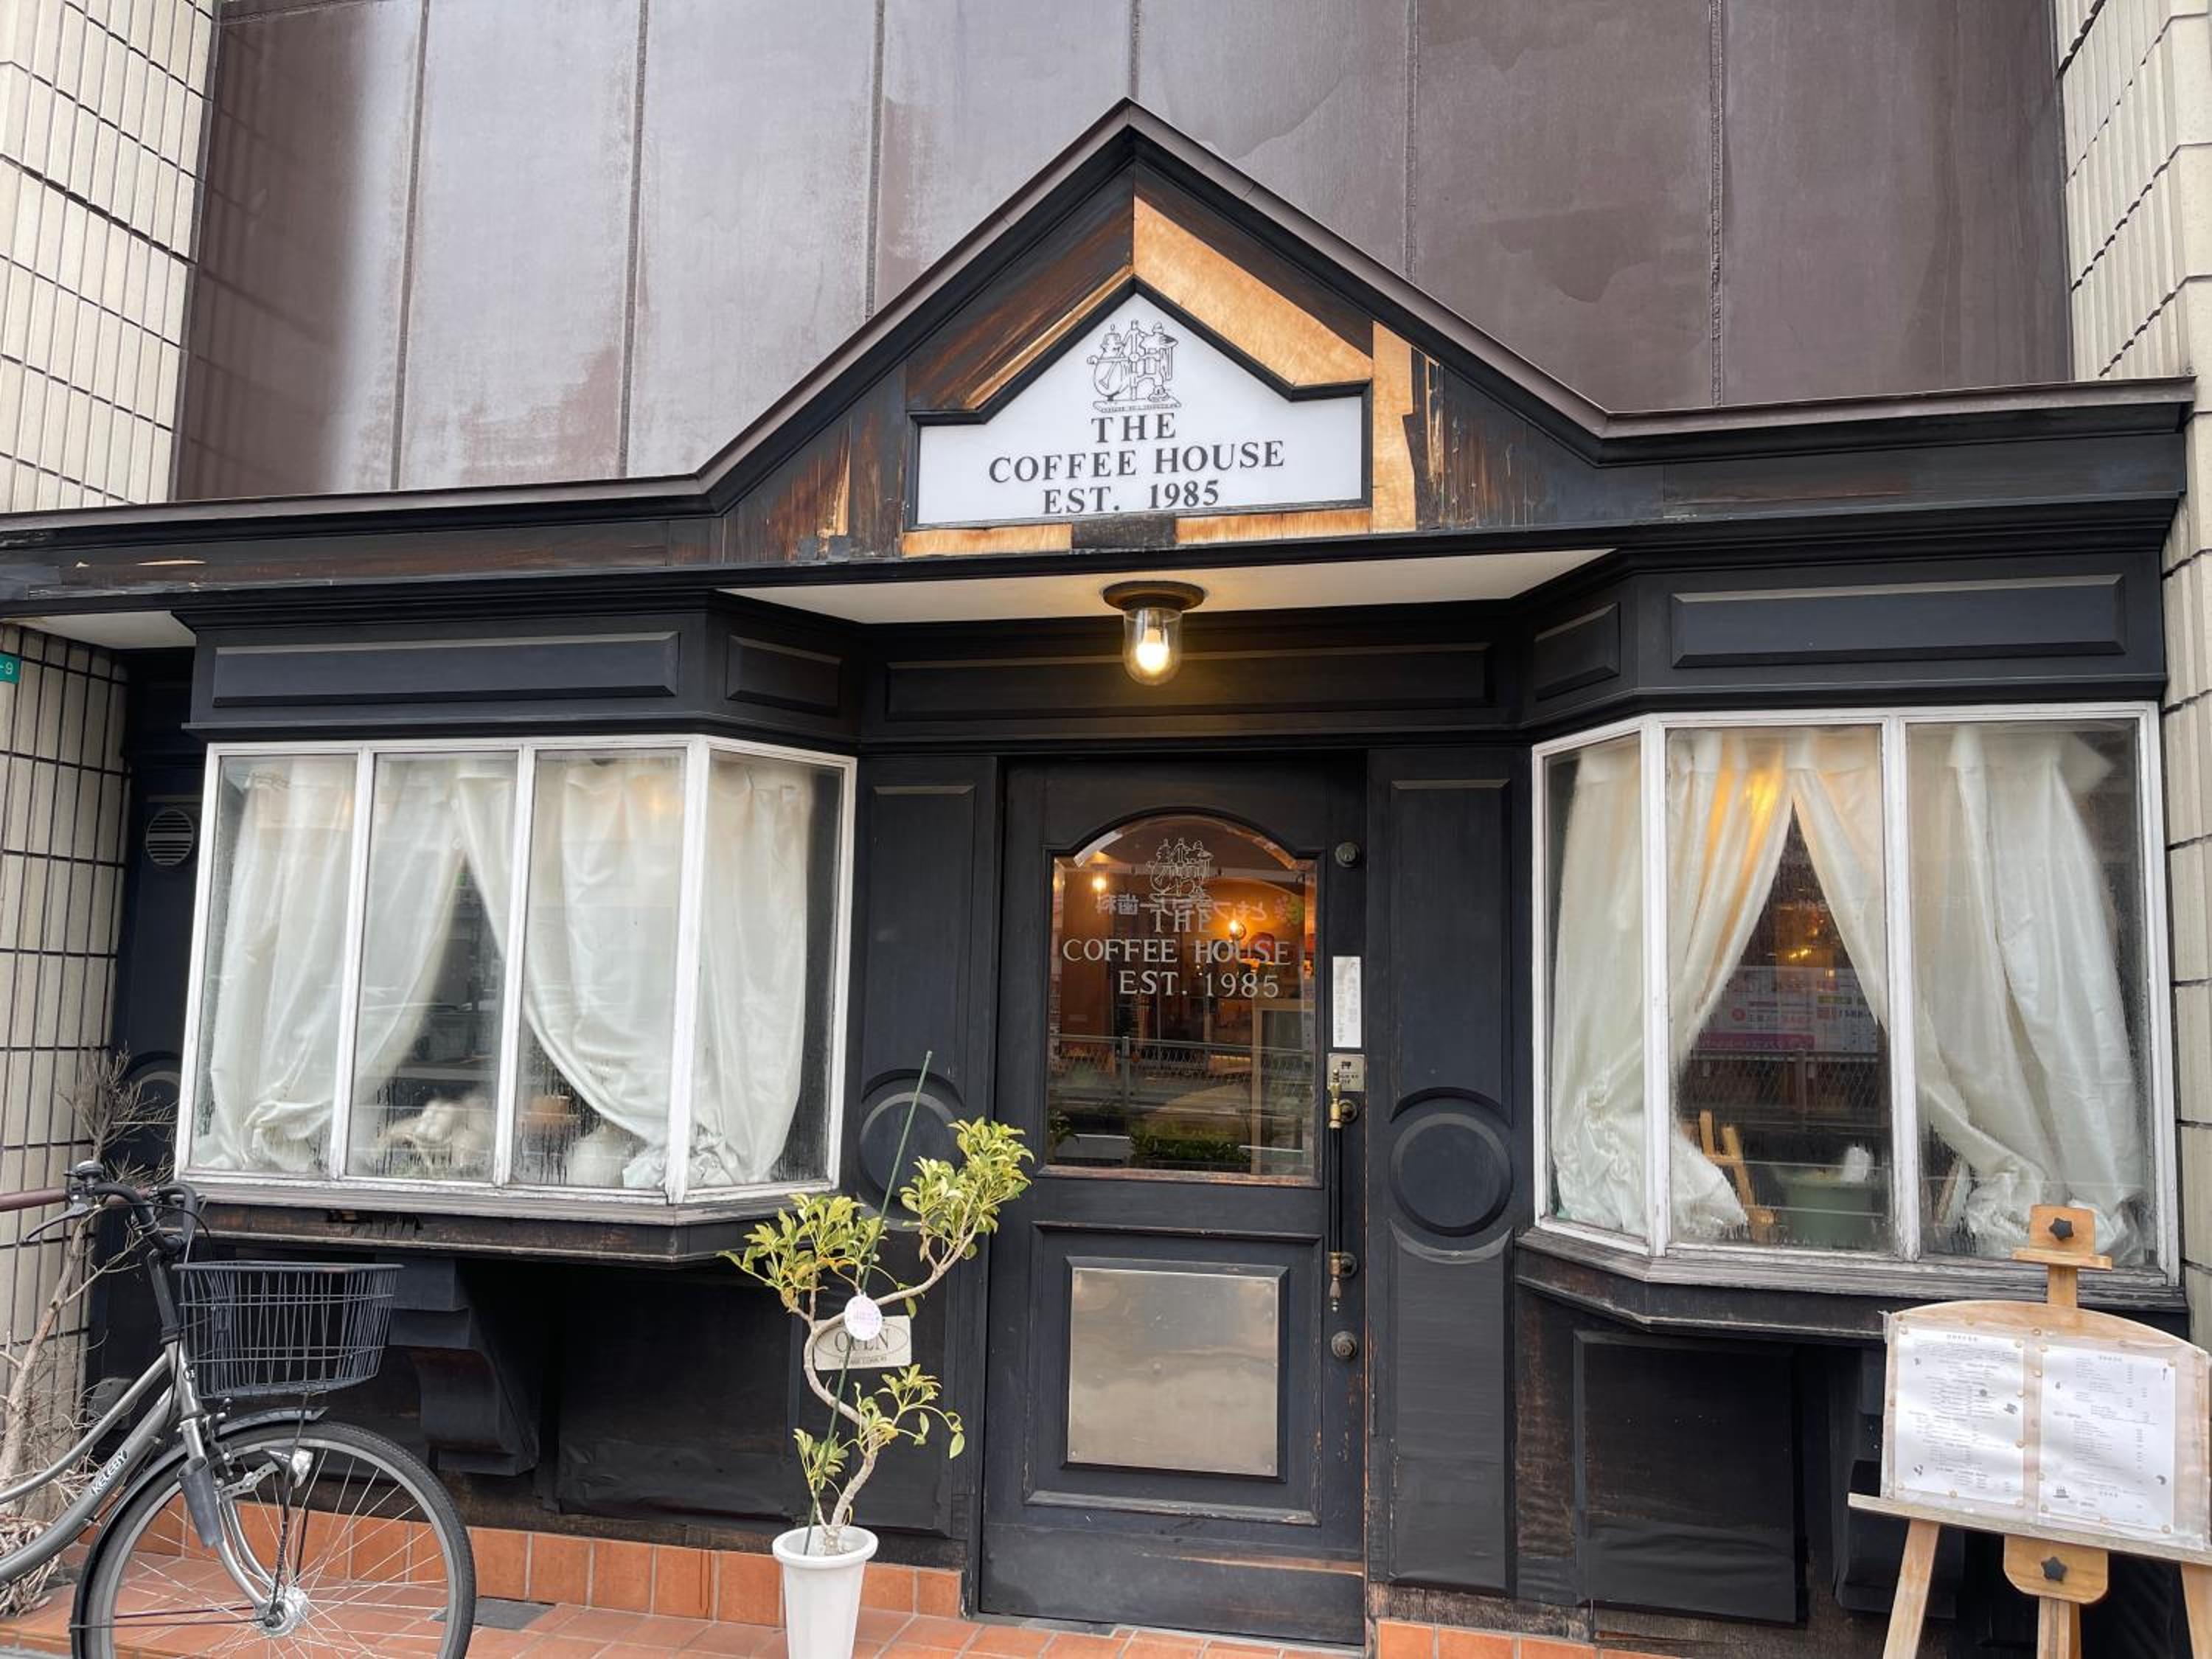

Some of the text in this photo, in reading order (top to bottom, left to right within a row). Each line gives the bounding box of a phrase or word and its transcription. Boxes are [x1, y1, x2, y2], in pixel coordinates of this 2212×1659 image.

[1091, 412, 1176, 442] THE
[989, 441, 1284, 483] COFFEE HOUSE
[1043, 479, 1220, 514] EST. 1985
[1150, 909, 1211, 933] THE
[1063, 939, 1290, 965] COFFEE HOUSE
[1119, 970, 1279, 998] EST. 1985
